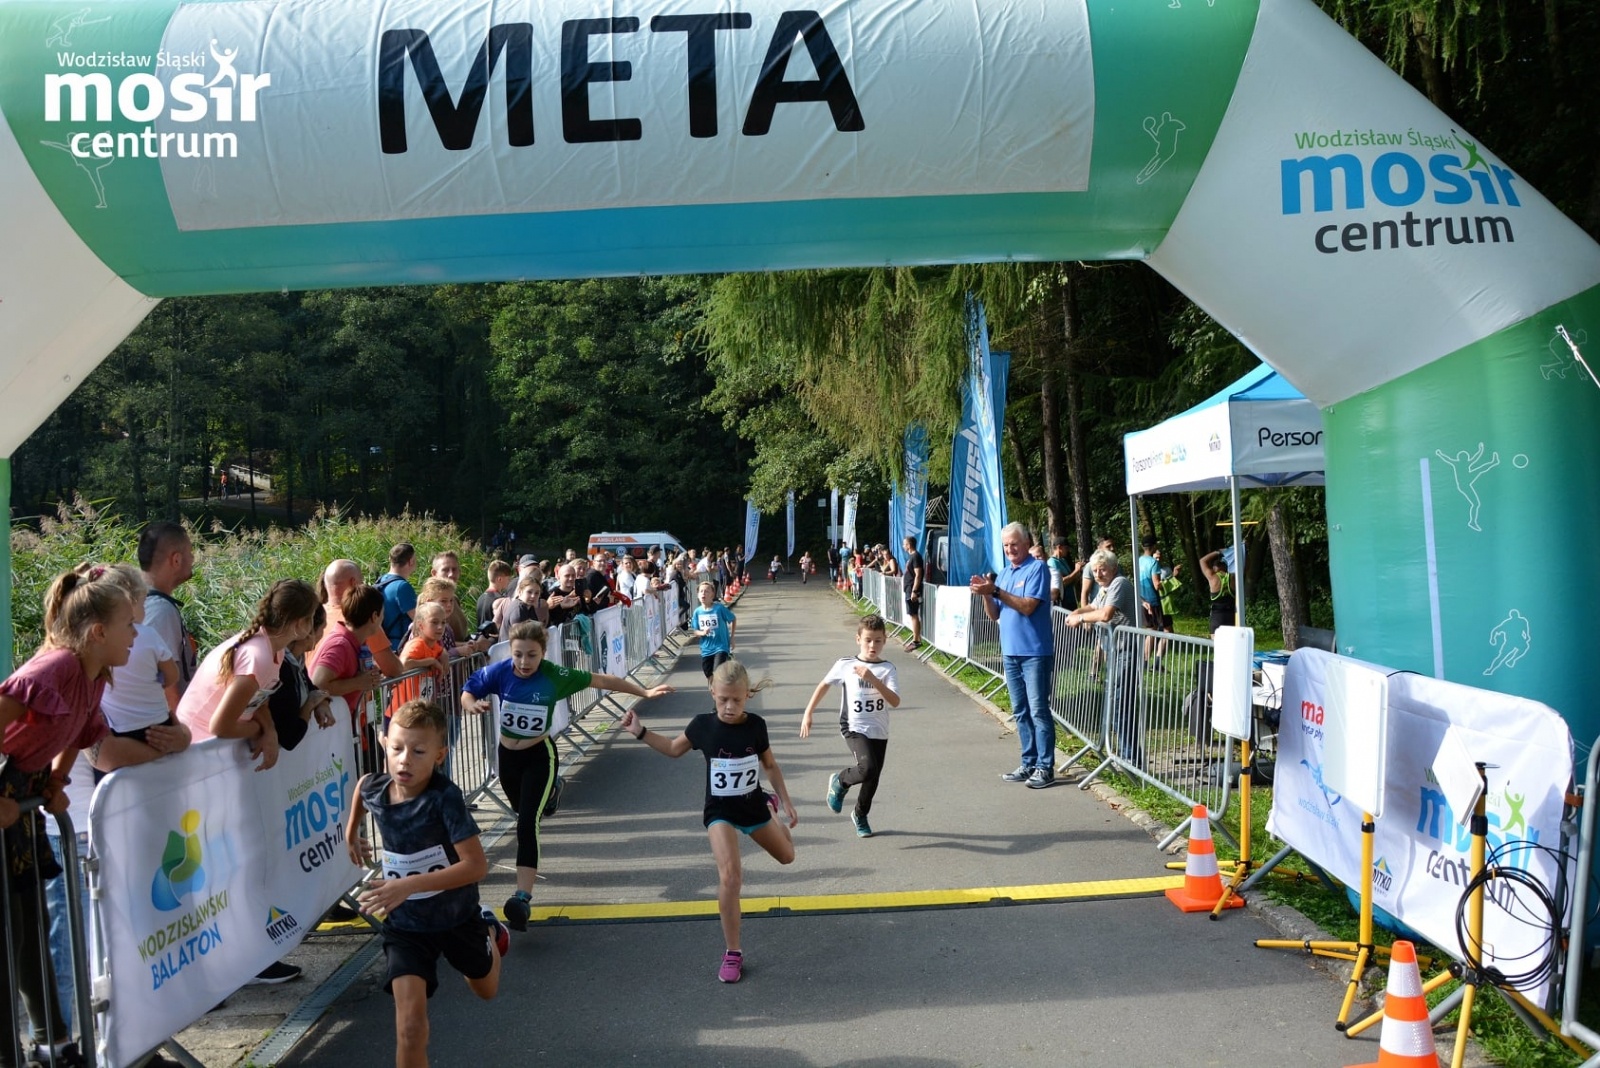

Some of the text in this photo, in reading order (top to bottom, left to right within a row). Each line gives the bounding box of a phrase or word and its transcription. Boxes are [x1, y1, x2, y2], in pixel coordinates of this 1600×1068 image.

[378, 10, 866, 154] META
[1295, 127, 1456, 151] Wodzisław Śląski
[1281, 151, 1521, 215] mosir
[1315, 211, 1515, 254] centrum
[700, 619, 717, 628] 363
[502, 712, 544, 732] 362
[854, 698, 884, 713] 358
[714, 768, 757, 789] 372
[1426, 849, 1517, 914] centum
[138, 889, 228, 964] WODZISŁAWSKI
[266, 914, 298, 941] MITKO
[151, 922, 223, 991] BALATON
